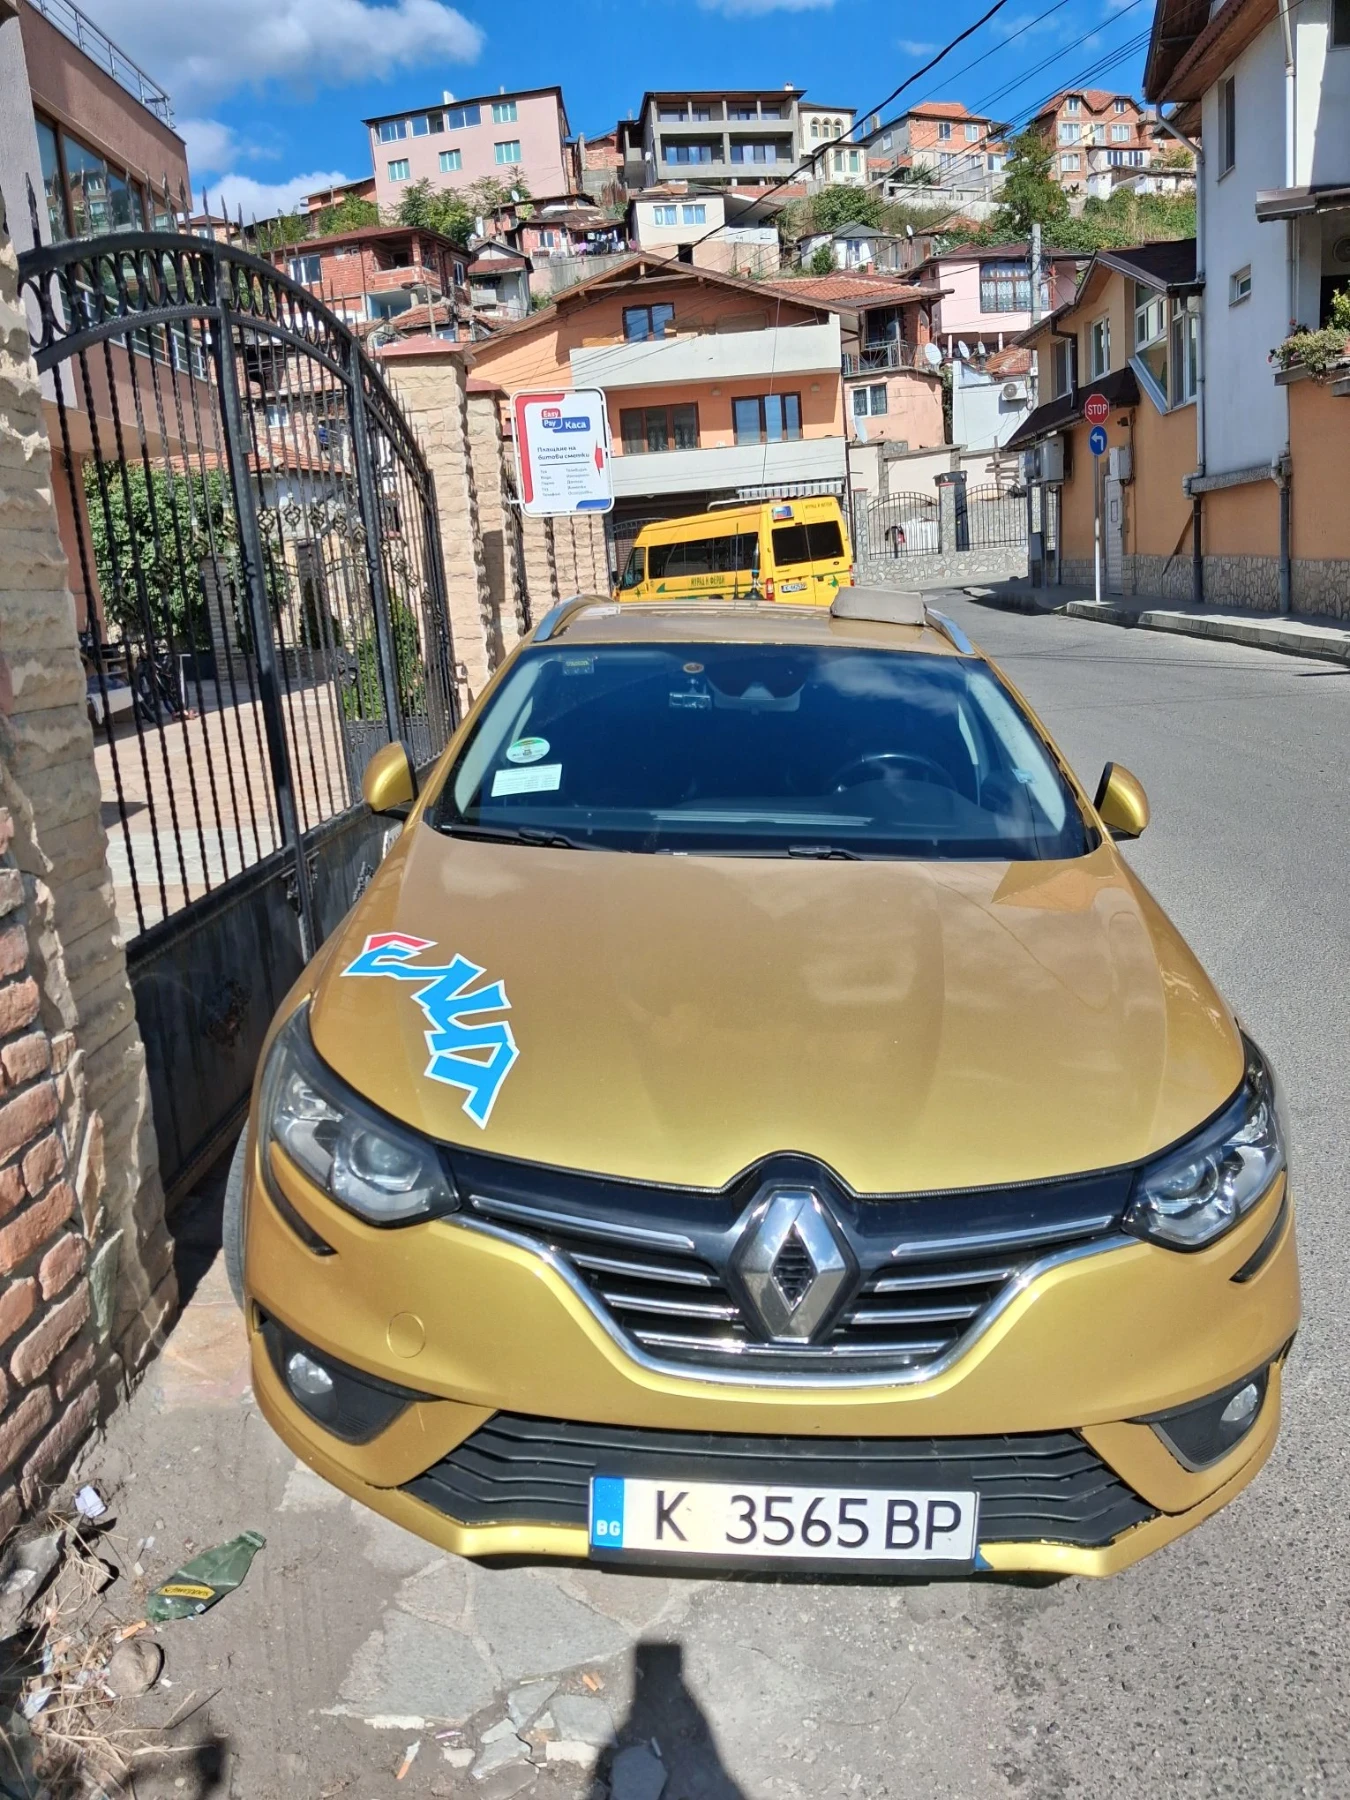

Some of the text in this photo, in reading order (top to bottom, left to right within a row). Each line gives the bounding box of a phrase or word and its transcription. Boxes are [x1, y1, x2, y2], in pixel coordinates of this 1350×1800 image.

[542, 410, 559, 418] Easy
[1087, 403, 1108, 416] STOP
[544, 419, 557, 428] Pay
[565, 420, 587, 430] Каса
[537, 453, 564, 461] битови
[653, 1490, 690, 1541] K
[726, 1494, 869, 1548] 3565
[595, 1519, 621, 1536] BG
